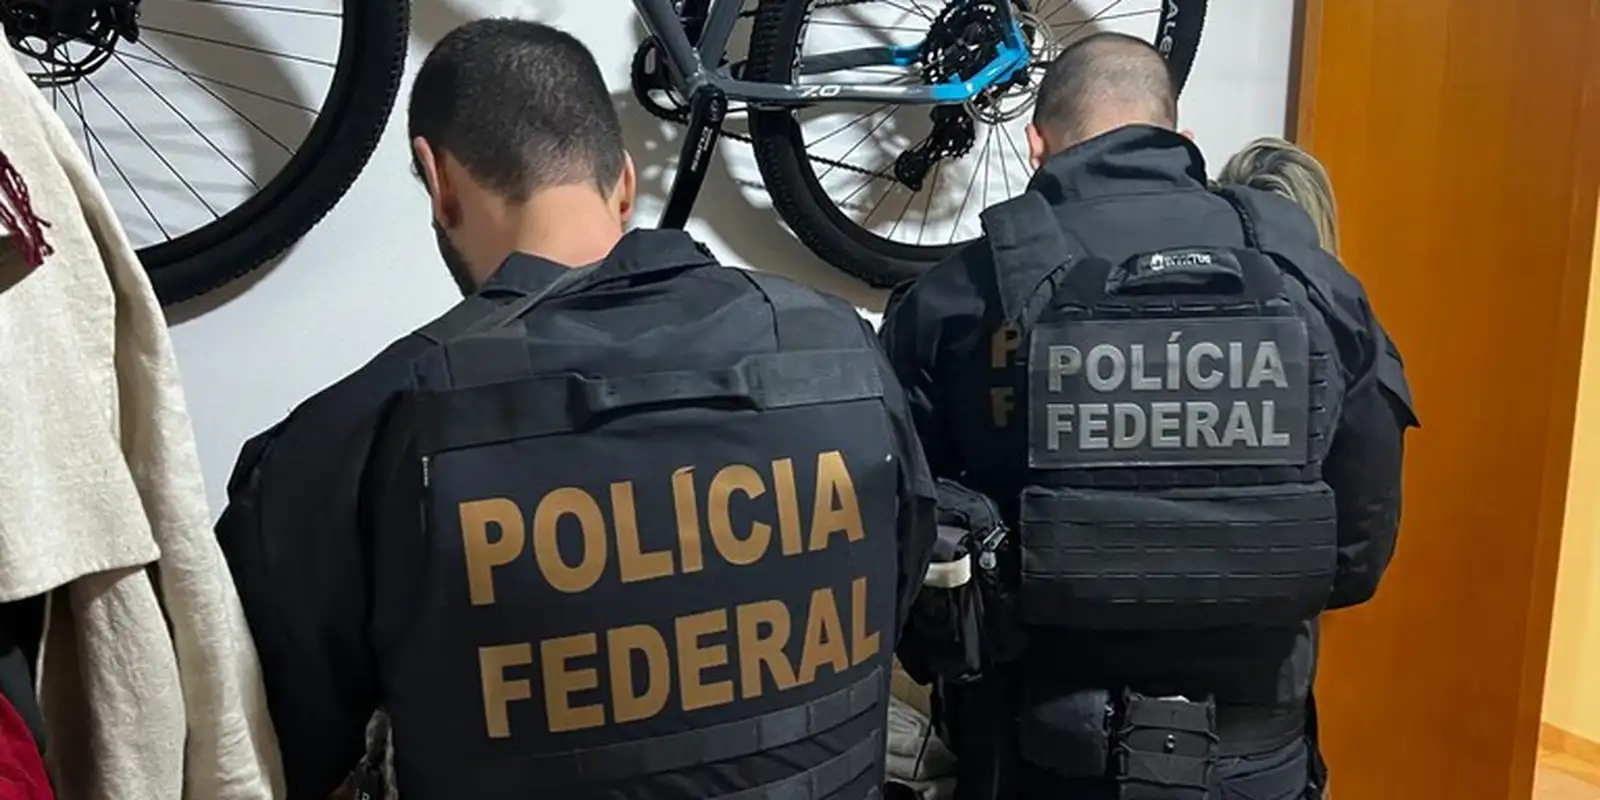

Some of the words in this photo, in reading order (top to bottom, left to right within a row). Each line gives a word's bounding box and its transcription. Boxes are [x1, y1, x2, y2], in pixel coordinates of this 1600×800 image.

[1047, 331, 1289, 392] POLÍCIA
[1045, 400, 1291, 450] FEDERAL
[478, 576, 881, 738] FEDERAL
